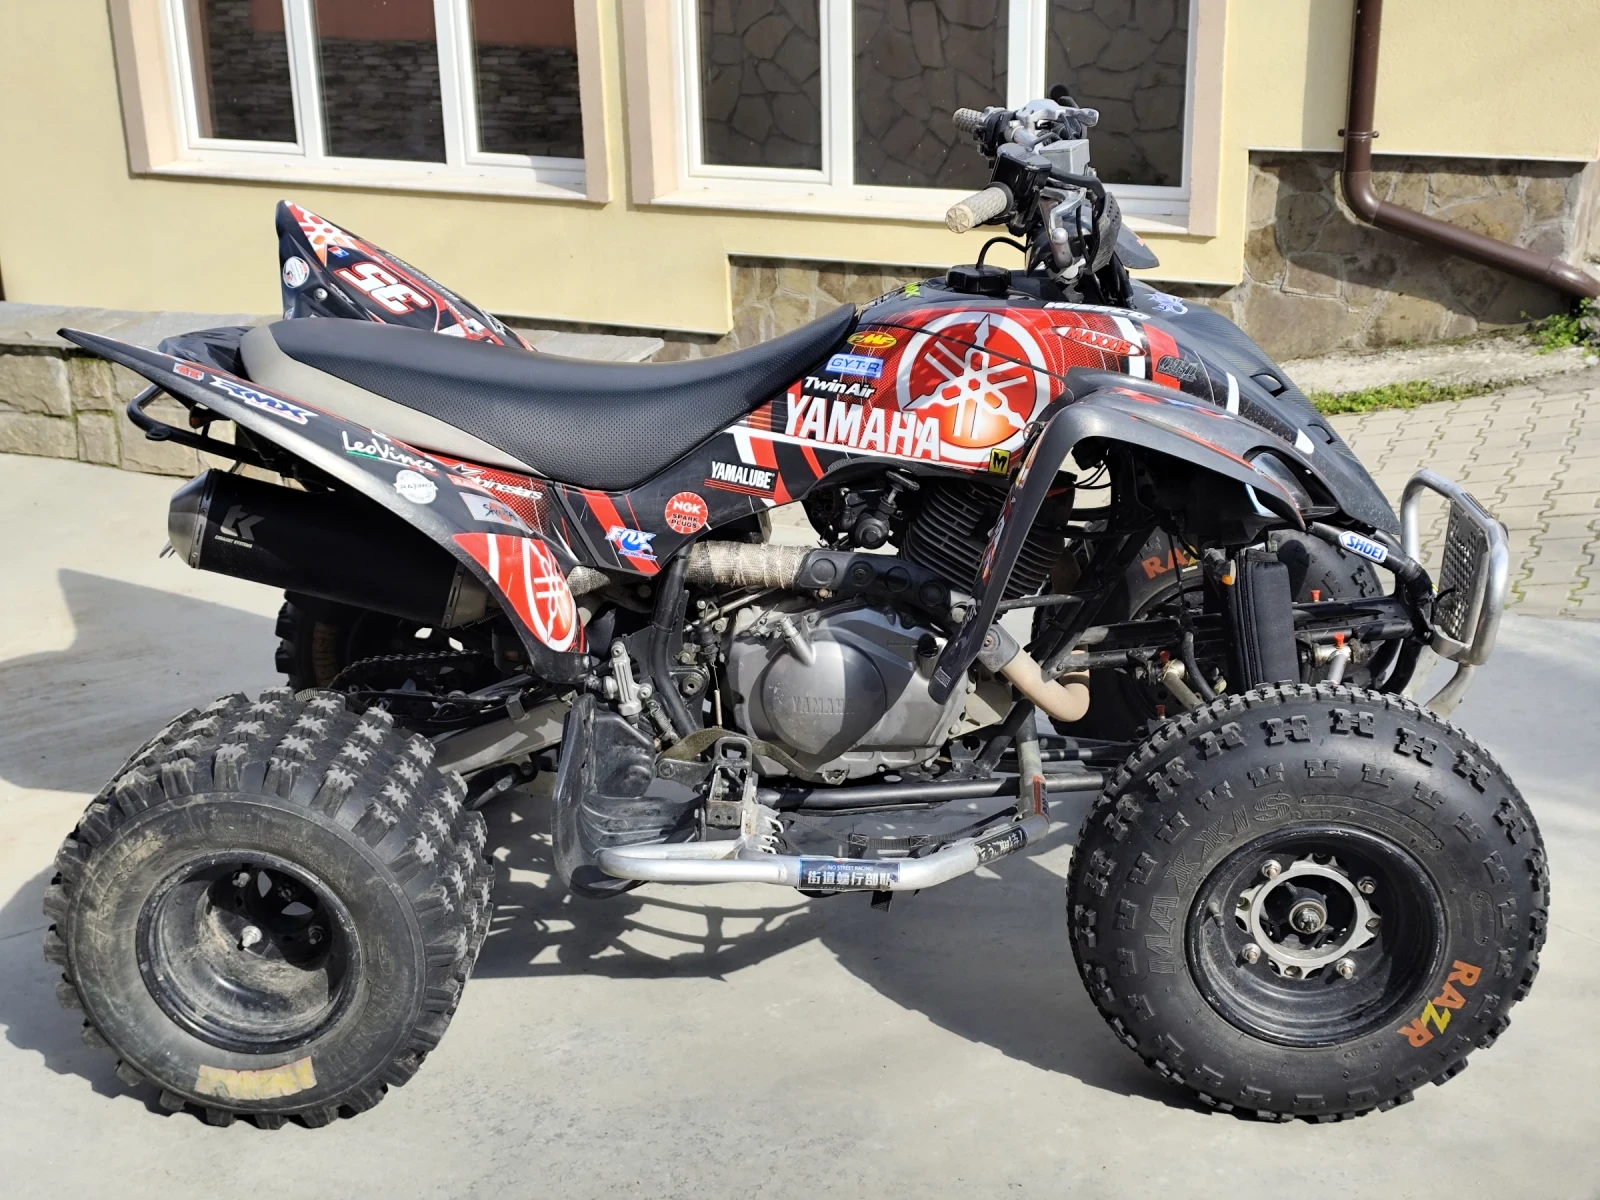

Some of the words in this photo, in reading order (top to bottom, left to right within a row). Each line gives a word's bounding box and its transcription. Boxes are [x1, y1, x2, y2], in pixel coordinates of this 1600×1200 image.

[335, 262, 431, 314] 35
[849, 333, 895, 345] FMF
[1066, 327, 1132, 353] MAXXIS
[805, 376, 847, 393] Twin
[845, 382, 876, 398] Air
[785, 394, 941, 461] YAMAHA
[342, 430, 437, 473] LeoVince
[711, 461, 773, 489] YAMALUBE
[672, 513, 698, 522] SPARK
[673, 500, 702, 514] NGK
[605, 525, 656, 547] FOX
[670, 519, 697, 529] PLUGS
[1346, 535, 1386, 561] SHOEI
[1144, 792, 1292, 974] MAXXIS
[1396, 959, 1483, 1048] RAZR
